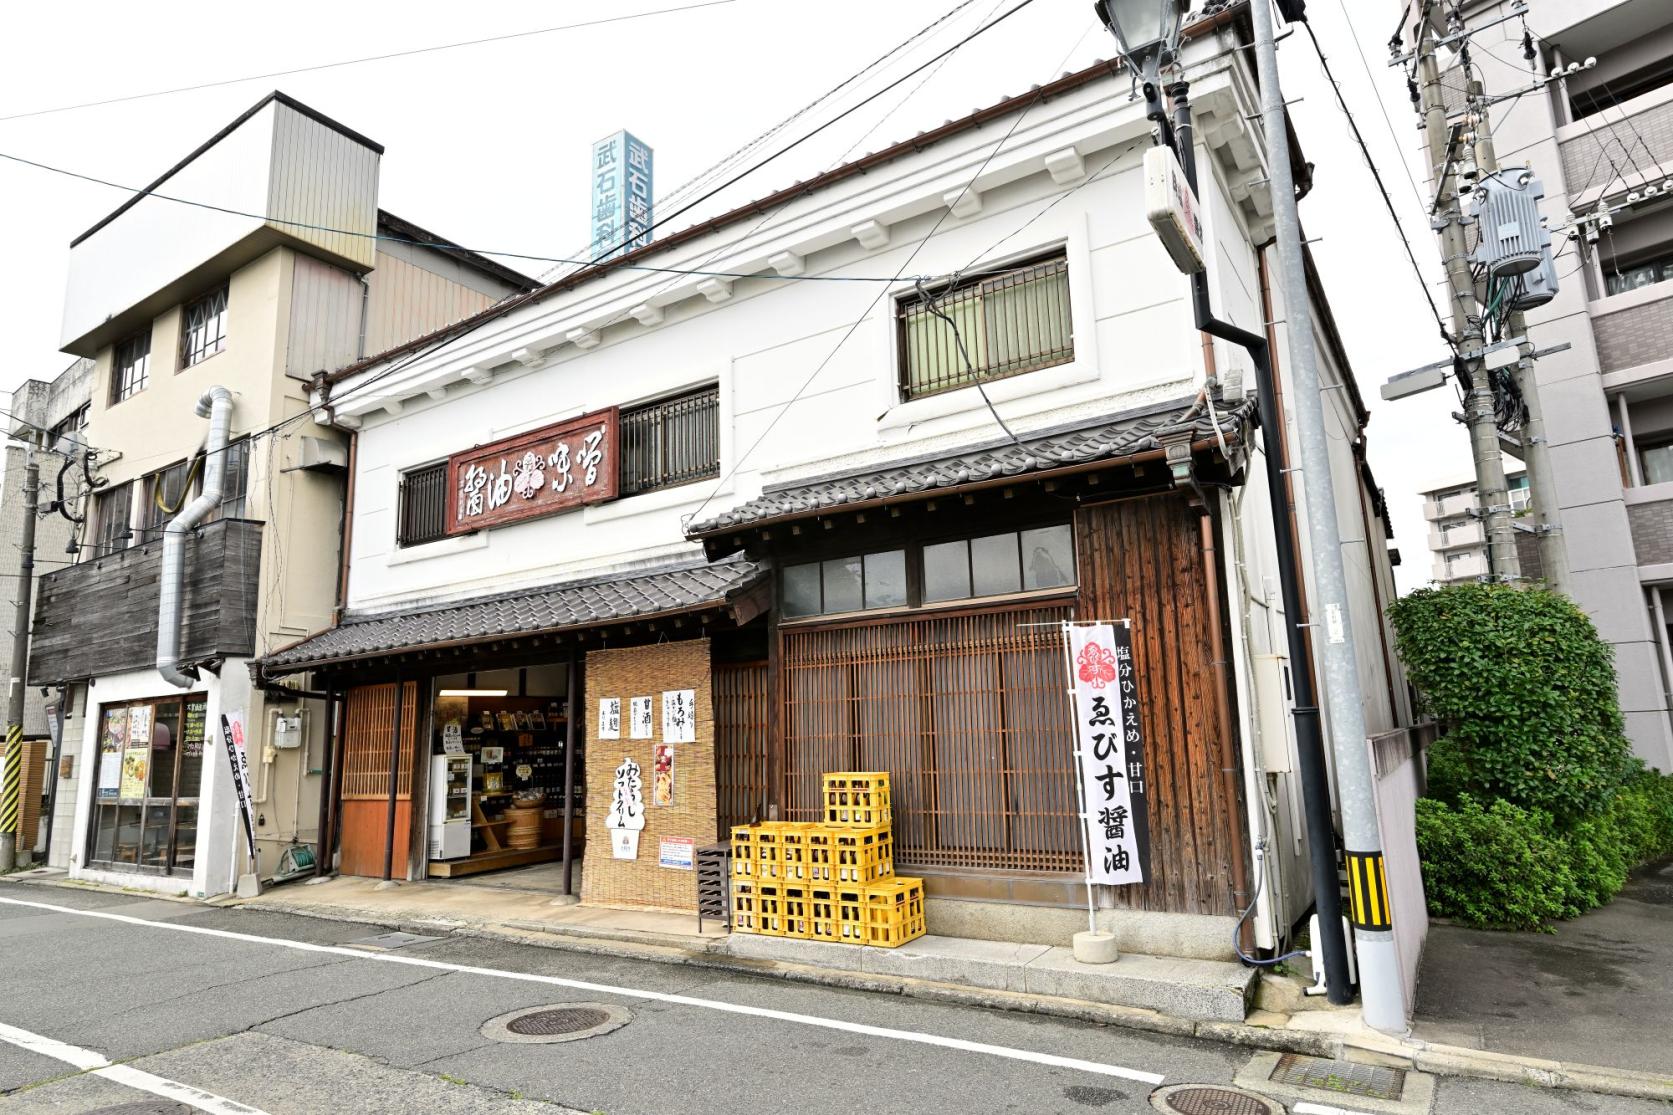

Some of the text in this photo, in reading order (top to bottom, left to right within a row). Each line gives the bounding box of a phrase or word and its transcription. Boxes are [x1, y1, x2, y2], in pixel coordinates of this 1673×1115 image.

[596, 140, 617, 258] 武石歯科
[628, 141, 649, 252] 武石歯科
[642, 698, 651, 724] 甘酒
[676, 692, 686, 727] もろみ
[1116, 646, 1144, 794] 塩分ひかえめ・甘口
[616, 769, 625, 828] ソフトクリーム
[626, 764, 639, 817] みたらし
[1089, 696, 1129, 874] ゑびす醤油
